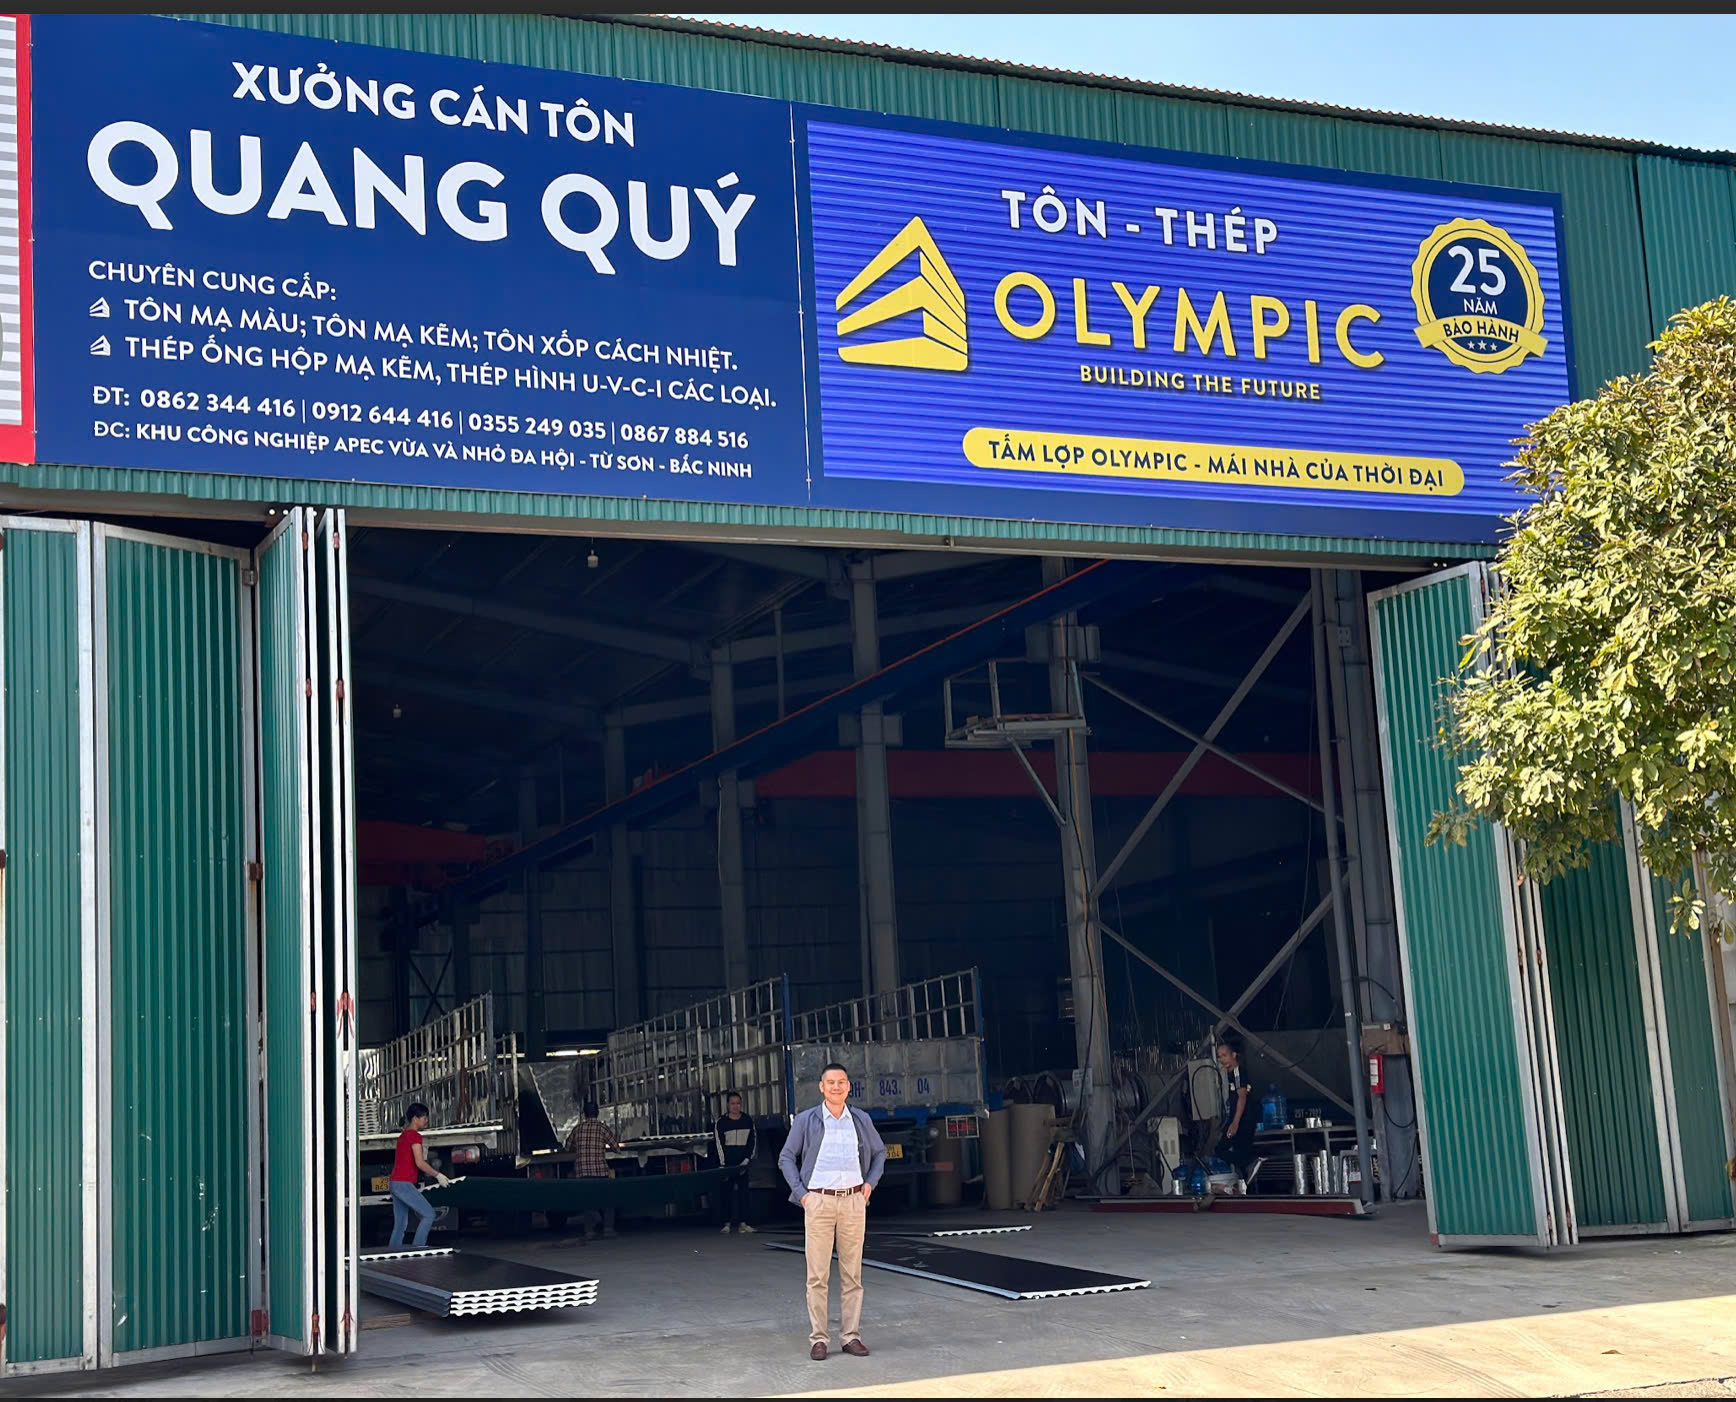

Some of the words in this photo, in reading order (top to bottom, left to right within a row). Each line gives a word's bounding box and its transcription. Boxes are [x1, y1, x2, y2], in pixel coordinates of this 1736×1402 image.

[232, 62, 415, 119] XƯỞNG
[430, 85, 528, 134] CÁN
[540, 98, 634, 147] TÔN
[88, 121, 507, 241] QUANG
[541, 172, 755, 274] QUÝ
[1002, 185, 1106, 238] TÔN
[1156, 207, 1277, 253] THÉP
[89, 261, 194, 288] CHUYÊN
[203, 271, 274, 294] CUNG
[282, 272, 336, 300] CẤP:
[1449, 246, 1505, 295] 25
[994, 272, 1384, 367] OLYMPIC
[1443, 318, 1472, 337] BẢO
[1477, 319, 1519, 343] HÀNH
[1464, 298, 1497, 314] NĂM
[124, 297, 181, 323] TÔN
[191, 305, 232, 332] MẠ
[240, 307, 306, 338] MÀU;
[312, 313, 365, 339] TÔN
[374, 321, 413, 348] MẠ
[421, 323, 478, 352] KẼM;
[484, 328, 534, 353] TÔN
[541, 330, 588, 357] XỐP
[595, 338, 659, 363] CÁCH
[667, 346, 737, 373] NHIỆT.
[125, 336, 193, 360] THÉP
[202, 335, 263, 366] ỐNG
[272, 346, 327, 375] HỘP
[336, 354, 375, 380] MẠ
[383, 355, 441, 385] KẼM,
[447, 362, 507, 385] THÉP
[515, 365, 575, 391] HÌNH
[583, 374, 661, 398] U-V-C-I
[669, 378, 714, 401] CÁC
[721, 385, 776, 410] LOẠI.
[1081, 365, 1184, 389] BUILDING
[1193, 374, 1232, 392] THE
[1242, 378, 1320, 399] FUTURE
[93, 386, 129, 406] ĐT:
[141, 389, 199, 410] 0862
[207, 394, 250, 413] 344
[257, 398, 295, 417] 416
[312, 402, 361, 422] 0912
[369, 406, 411, 425] 644
[417, 410, 453, 428] 416
[469, 413, 519, 433] 0355
[526, 418, 563, 436] 249
[569, 420, 606, 439] 035
[621, 424, 669, 443] 0867
[675, 428, 712, 446] 884
[718, 431, 748, 448] 516
[94, 421, 129, 438] ĐC:
[137, 424, 181, 441] KHU
[187, 424, 248, 445] CÔNG
[254, 431, 329, 454] NGHIỆP
[334, 437, 384, 454] APEC
[388, 438, 429, 457] VỪA
[432, 441, 458, 459] VÀ
[463, 444, 505, 462] NHỎ
[511, 449, 536, 464] ĐA
[541, 448, 574, 470] HỘI
[590, 451, 613, 469] TỪ
[617, 456, 654, 472] SƠN
[670, 454, 703, 474] BẮC
[708, 461, 751, 478] NINH
[988, 434, 1035, 462] TẤM
[1043, 444, 1085, 469] LỢP
[1091, 448, 1187, 472] OLYMPIC
[1208, 453, 1247, 475] MÁI
[1254, 456, 1300, 479] NHÀ
[1306, 459, 1349, 480] CỦA
[1352, 463, 1402, 484] THỜI
[1409, 468, 1443, 491] ĐẠI
[917, 1077, 929, 1094] 04
